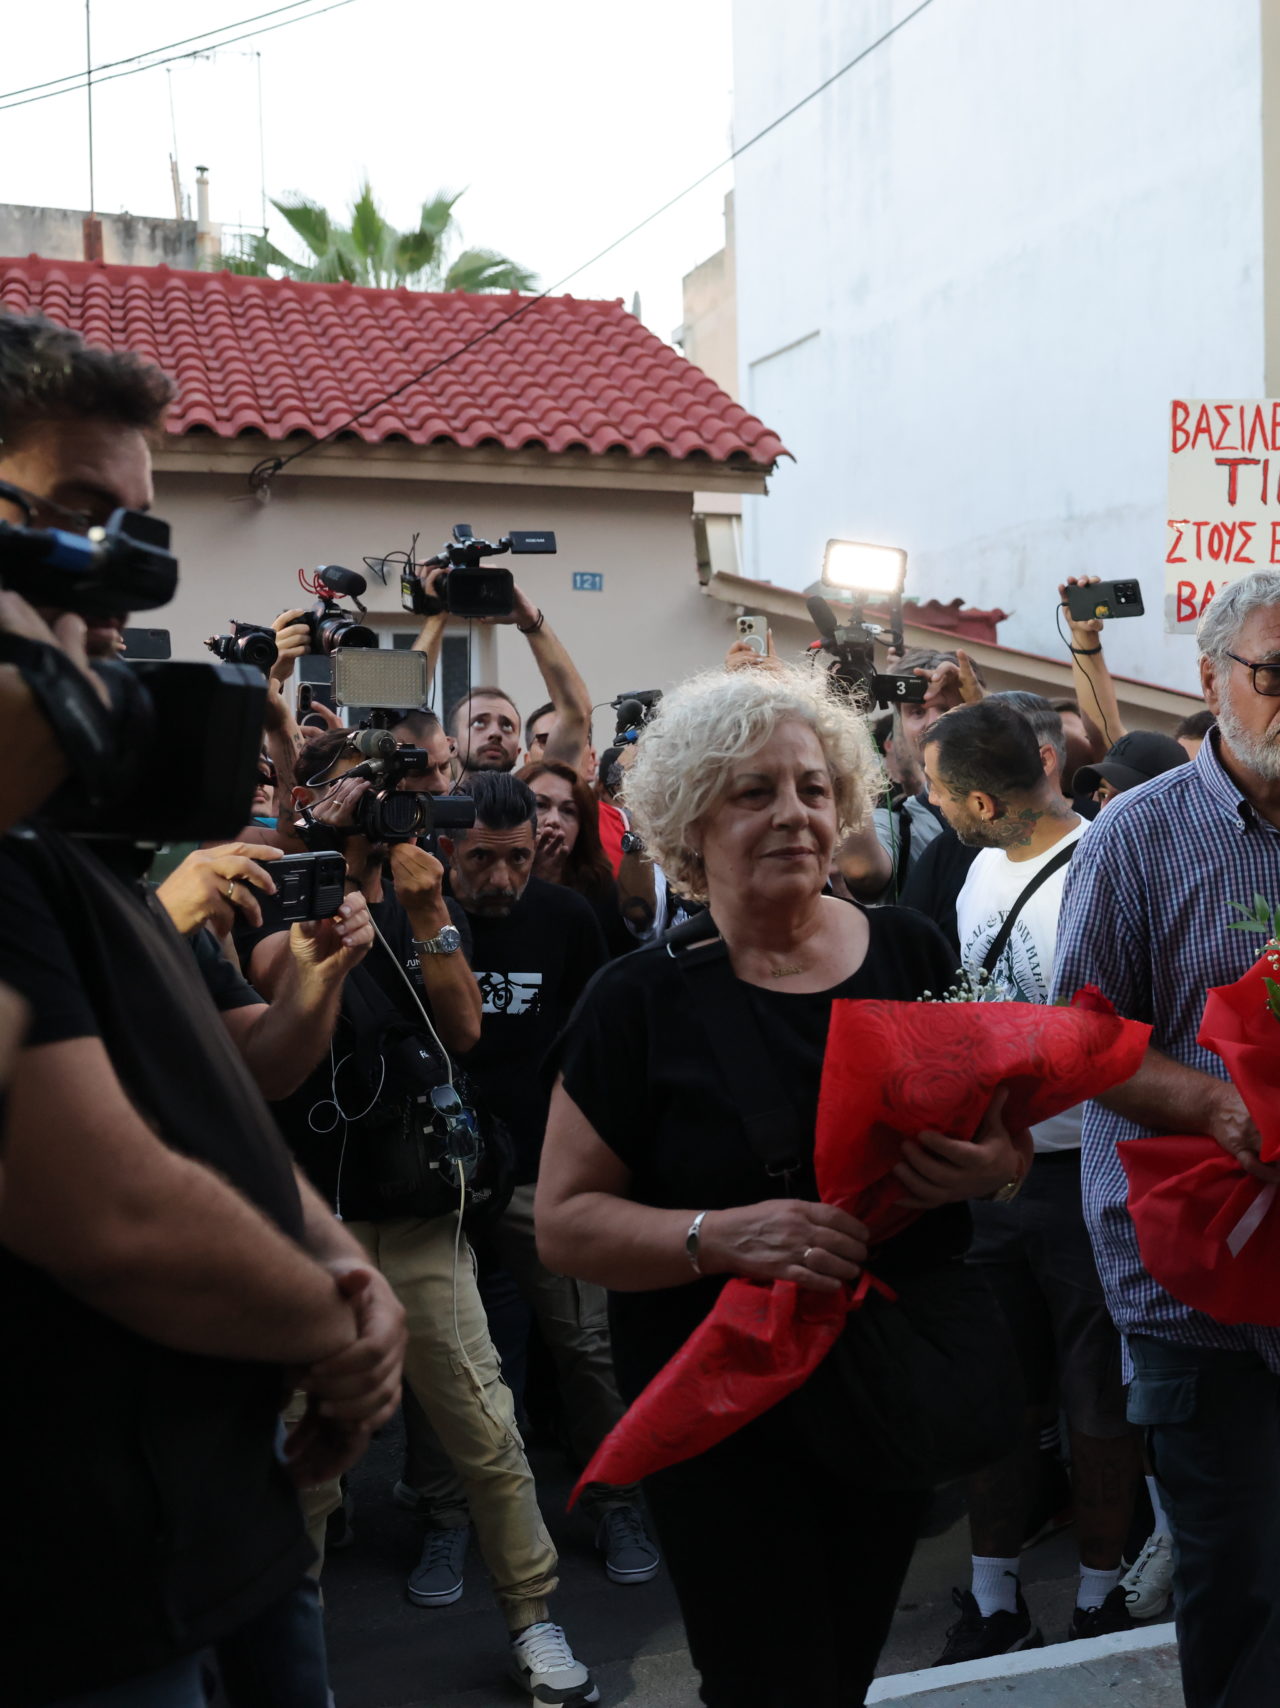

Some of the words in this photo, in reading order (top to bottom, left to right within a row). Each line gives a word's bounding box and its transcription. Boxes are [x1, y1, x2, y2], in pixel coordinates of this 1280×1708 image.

[1165, 519, 1257, 564] ΣΤΟΥΣ
[575, 574, 601, 590] 121
[896, 681, 906, 695] 3
